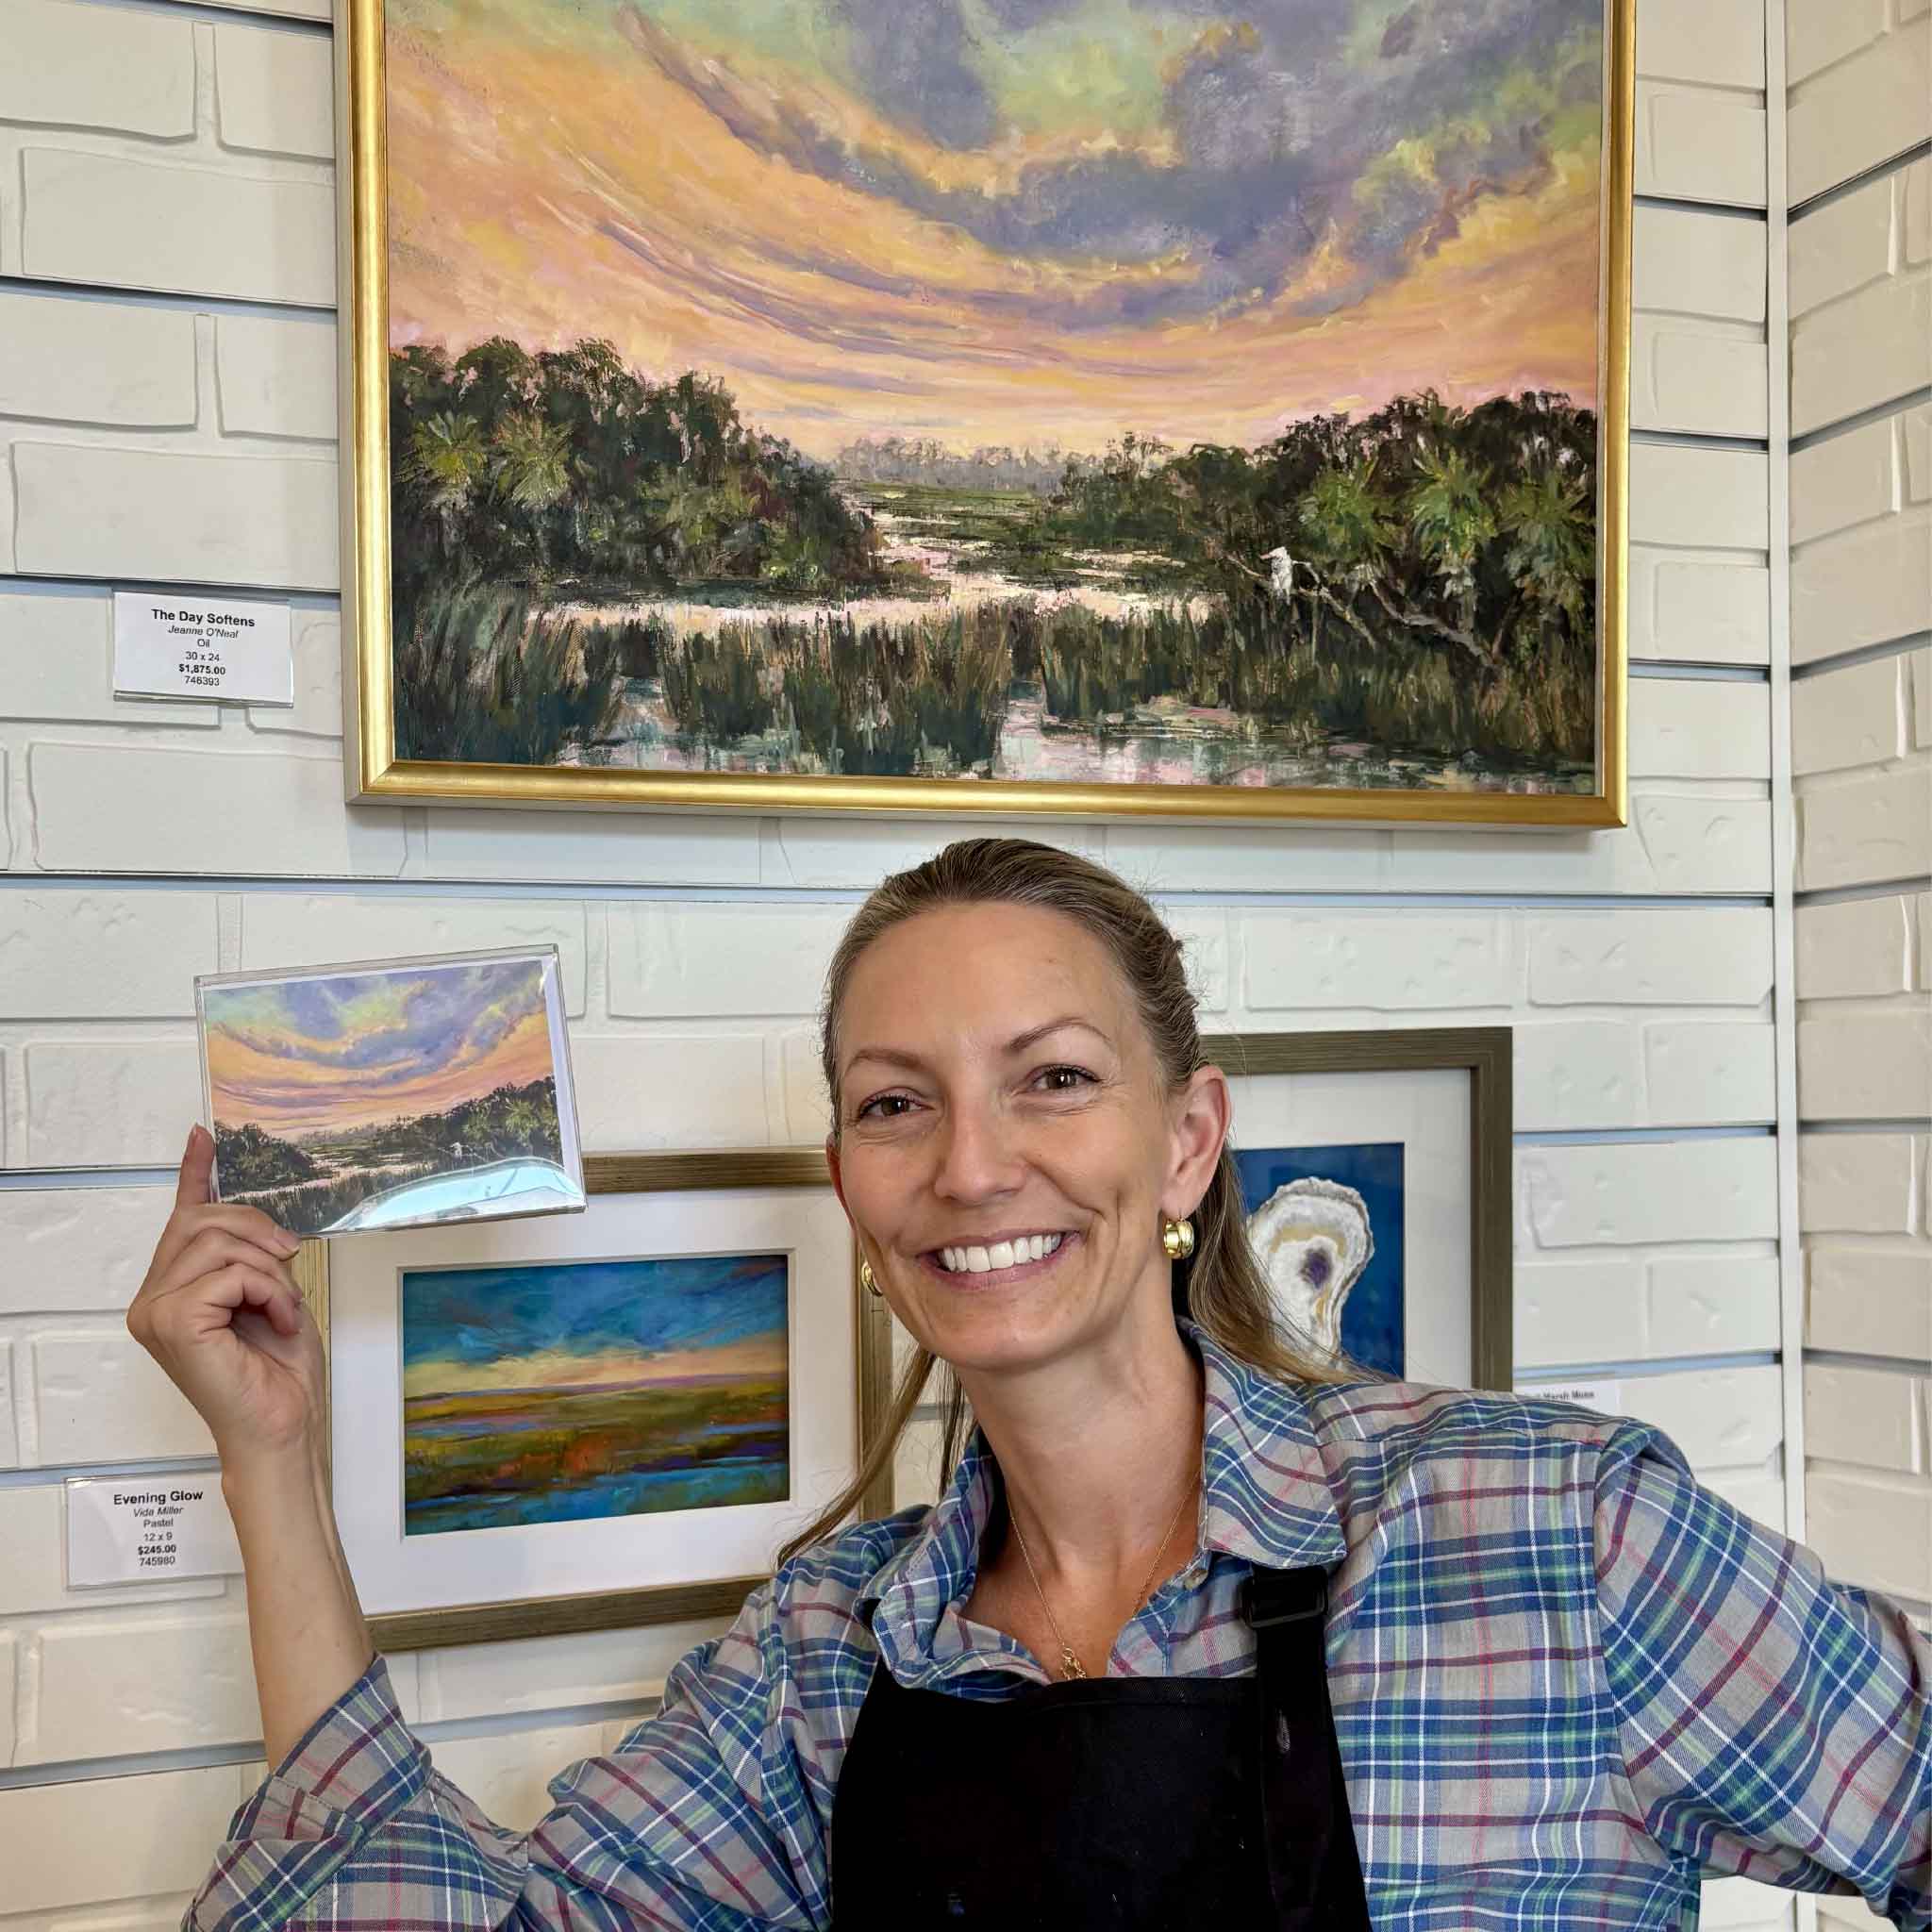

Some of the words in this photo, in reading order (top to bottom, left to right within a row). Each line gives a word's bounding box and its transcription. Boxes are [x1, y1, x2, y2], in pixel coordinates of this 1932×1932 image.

[151, 608, 175, 621] The
[179, 610, 203, 625] Day
[207, 613, 255, 627] Softens
[168, 625, 203, 636] Jeanne
[206, 627, 239, 639] O'Neal
[197, 639, 210, 648] Oil
[185, 651, 198, 661] 30
[208, 653, 220, 662] 24
[178, 663, 225, 675] $1,875.00
[184, 675, 220, 687] 746393
[113, 1492, 166, 1506] Evening
[170, 1491, 204, 1502] Glow
[133, 1507, 154, 1518] Vida
[158, 1506, 184, 1516] Miller
[143, 1518, 174, 1528] Pastel
[143, 1532, 156, 1542] 12
[165, 1531, 173, 1541] 9
[138, 1544, 176, 1556] $245.00
